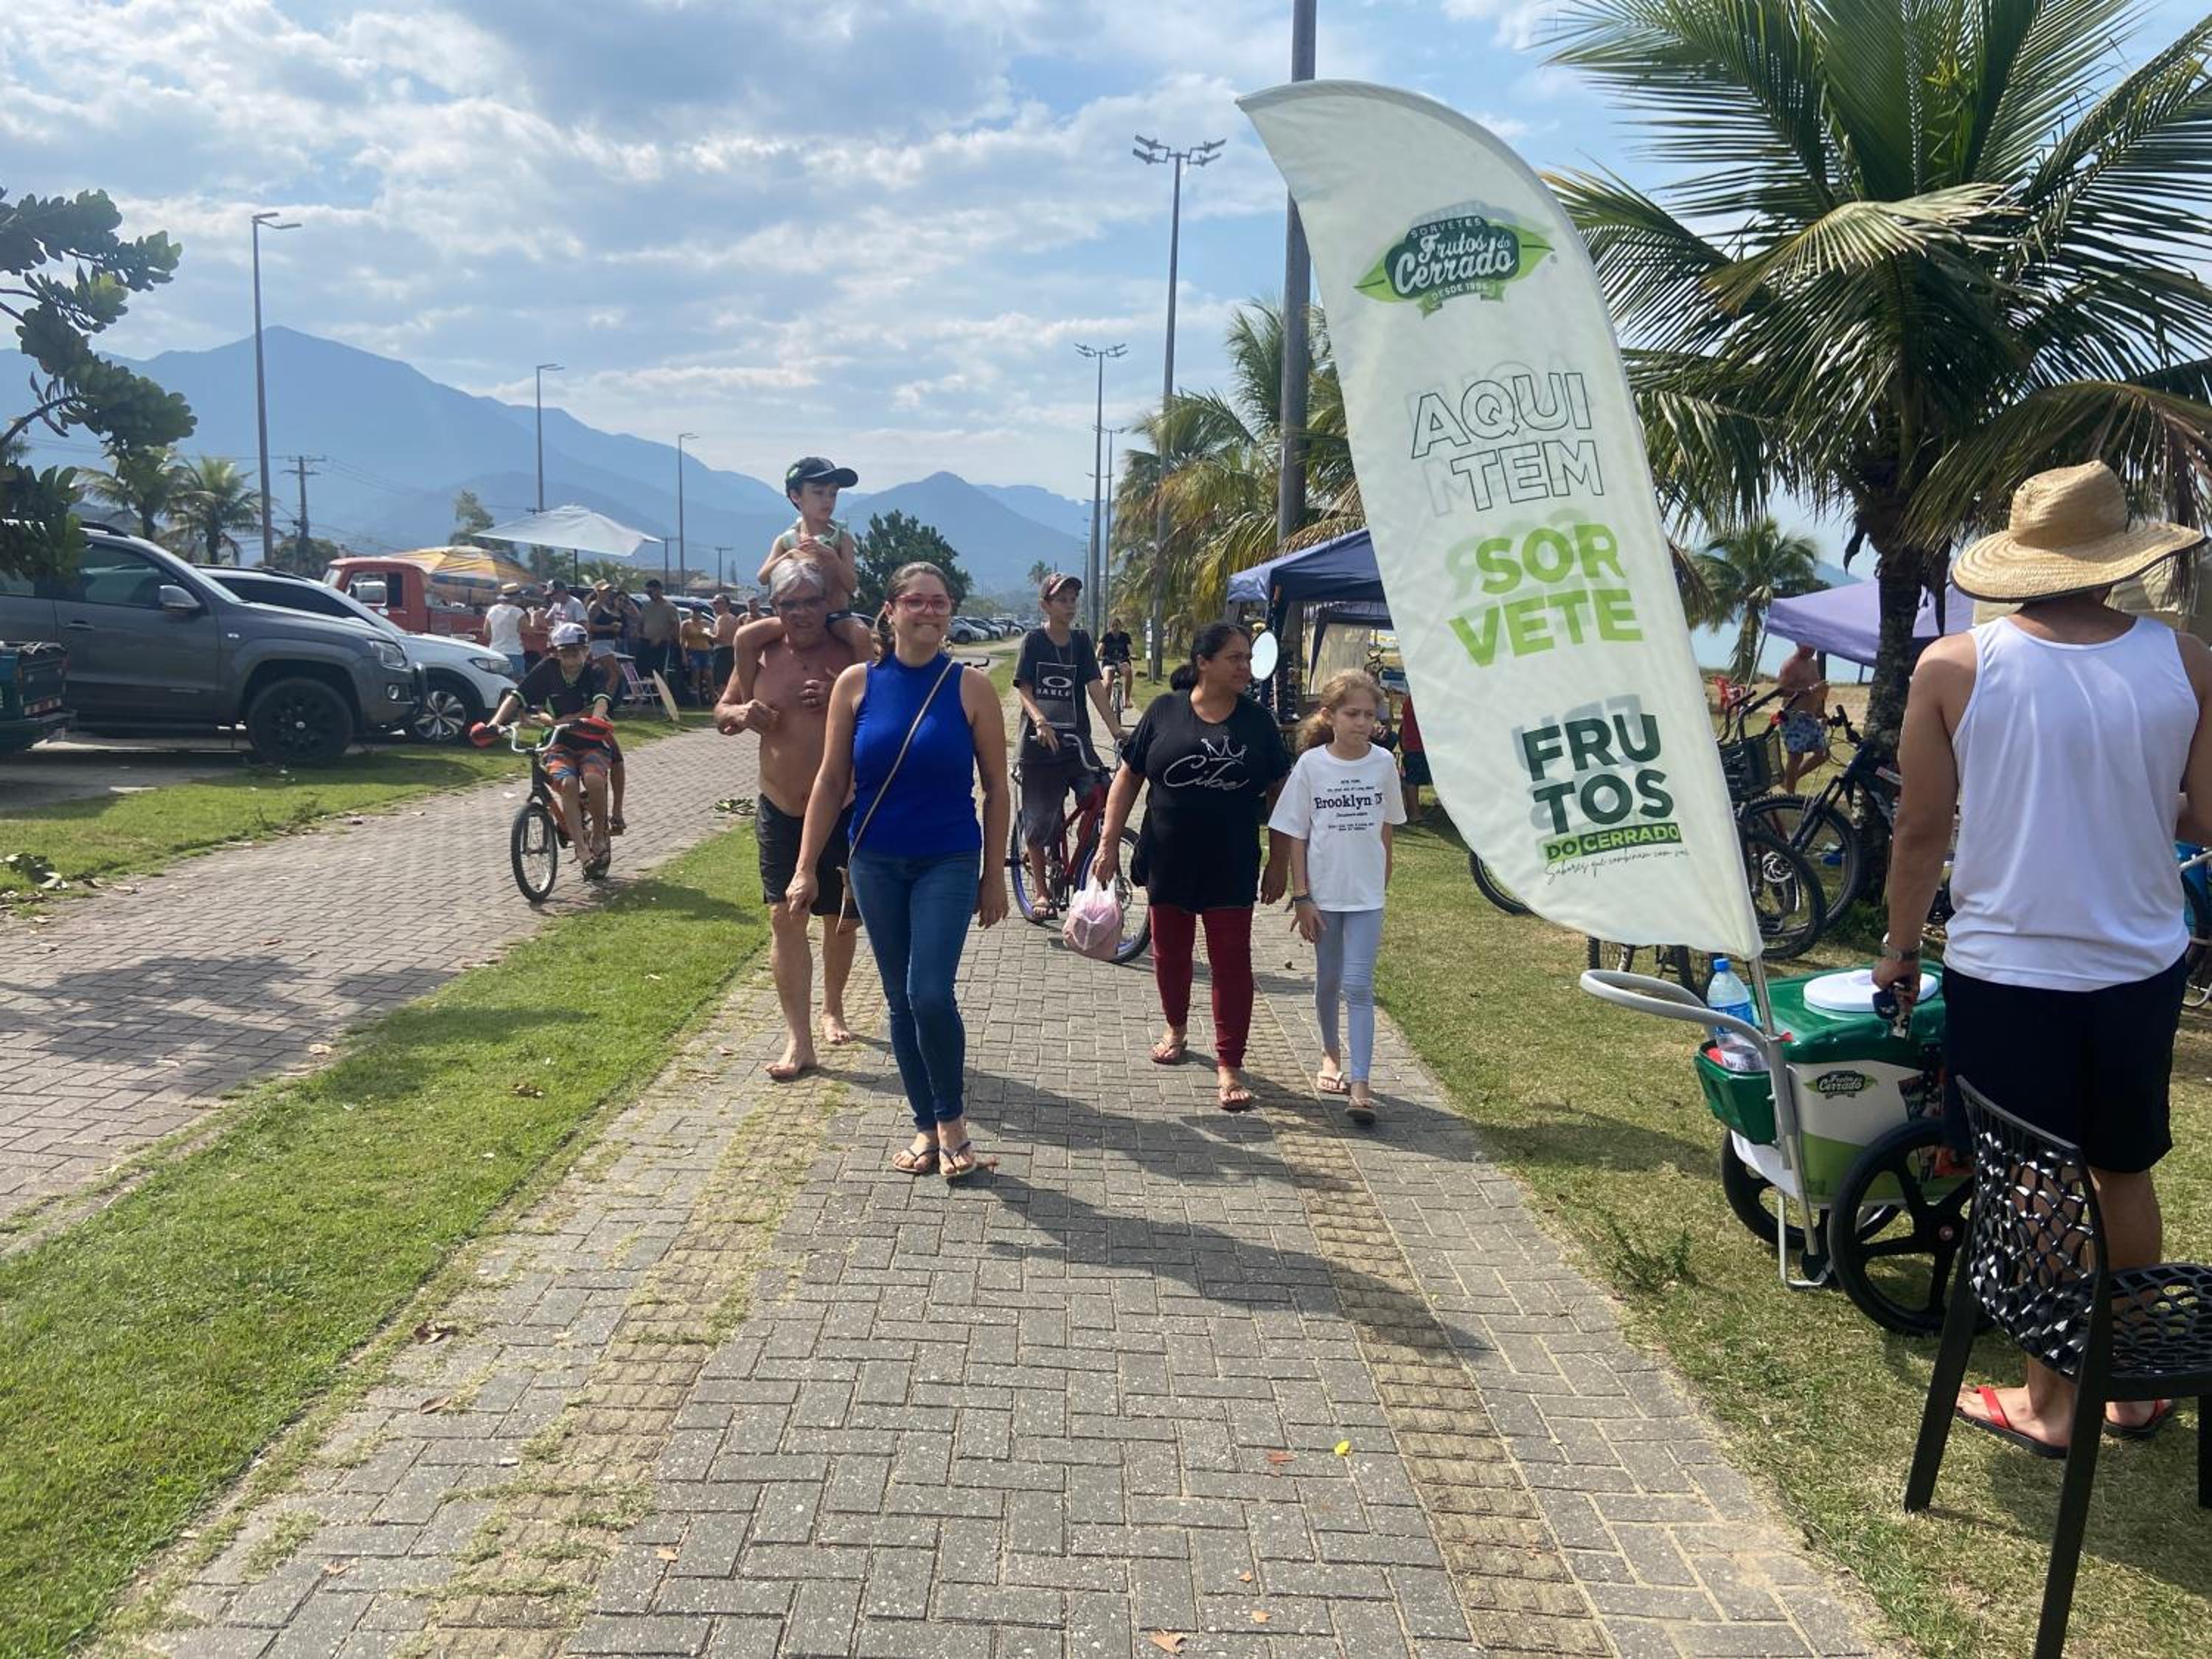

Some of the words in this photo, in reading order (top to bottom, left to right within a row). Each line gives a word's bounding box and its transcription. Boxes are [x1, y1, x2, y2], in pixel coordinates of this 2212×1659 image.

[1410, 218, 1482, 239] SORVETES
[1417, 232, 1487, 263] Frutos
[1497, 235, 1511, 248] do
[1394, 237, 1515, 294] Cerrado
[1411, 373, 1592, 459] AQUI
[1450, 439, 1604, 512] TEM
[1475, 524, 1626, 594] SOR
[1448, 588, 1644, 667] VETE
[1522, 713, 1661, 782] FRU
[1314, 794, 1372, 810] Brooklyn
[1533, 769, 1674, 835] TOS
[1546, 841, 1577, 860] DO
[1582, 824, 1679, 851] CERRADO
